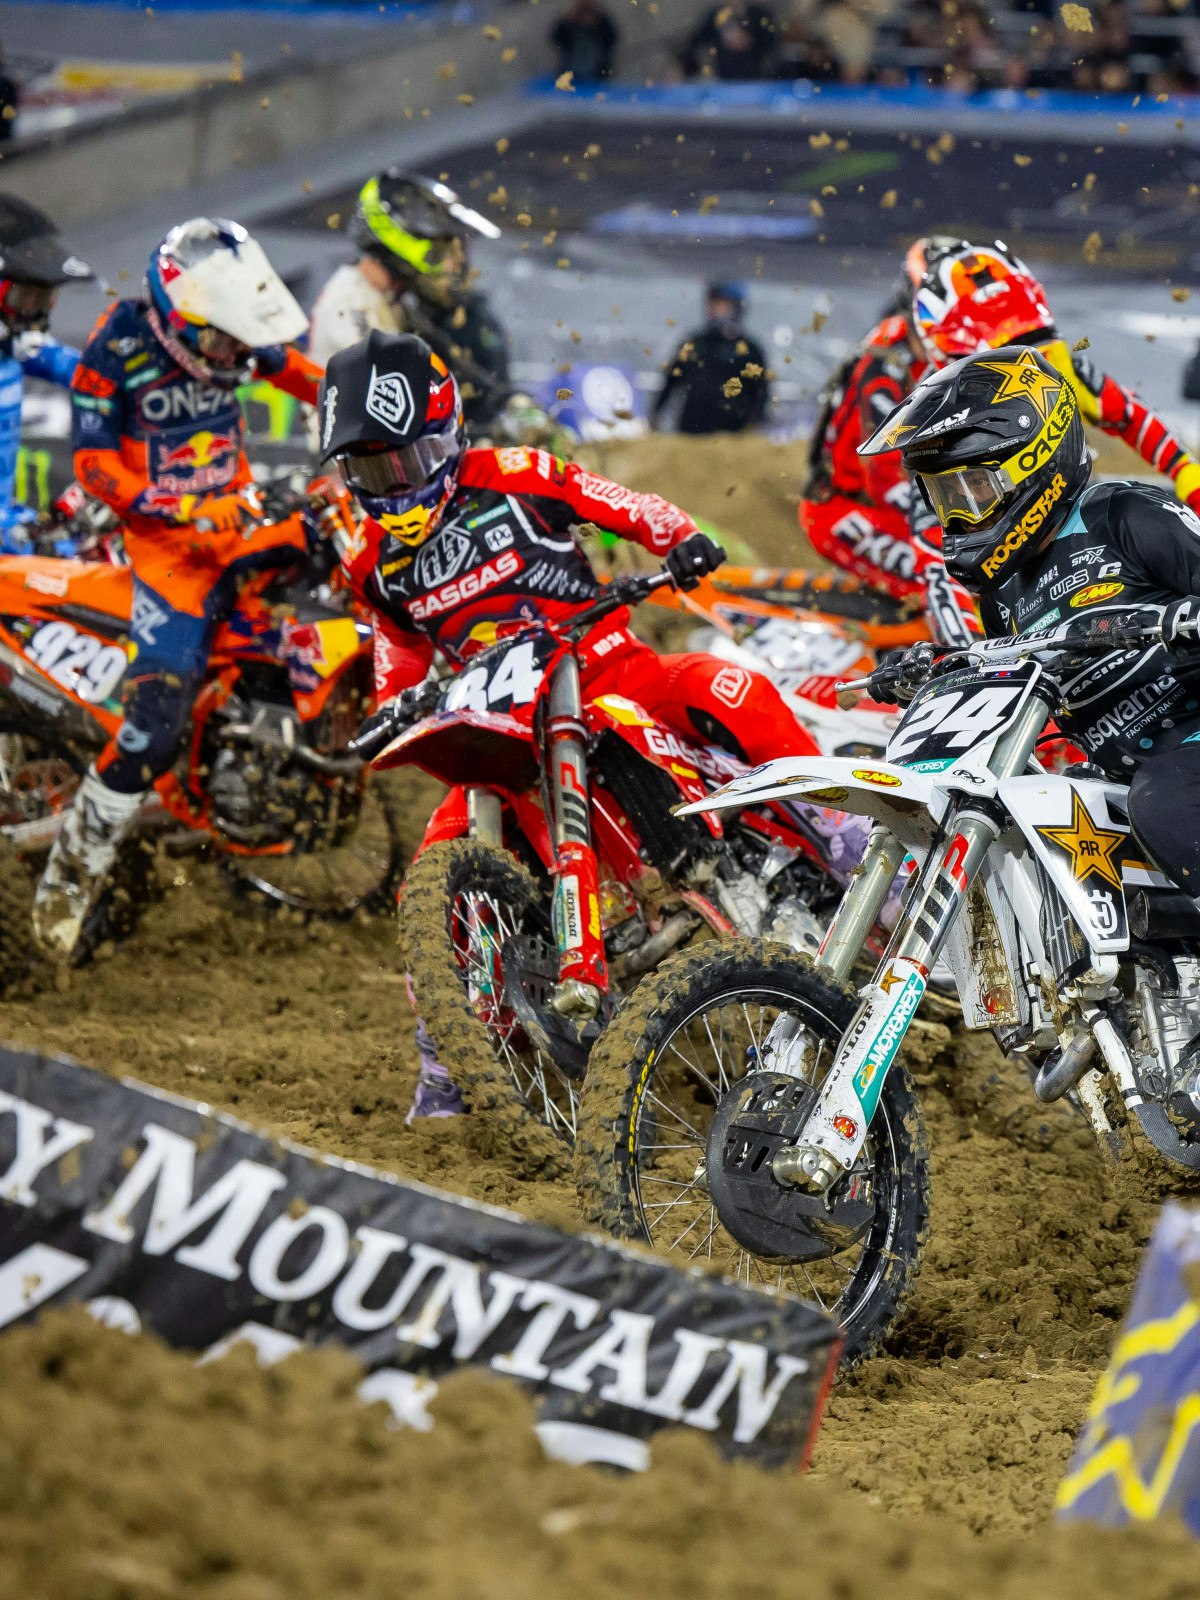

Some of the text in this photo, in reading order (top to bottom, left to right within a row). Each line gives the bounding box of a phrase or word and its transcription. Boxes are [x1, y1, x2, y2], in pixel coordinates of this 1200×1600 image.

[934, 419, 967, 437] RACING
[981, 472, 1067, 579] ROCKSTAR
[1071, 547, 1105, 567] SMX
[408, 552, 519, 620] GASGAS
[1049, 568, 1090, 600] WPS
[1070, 582, 1124, 607] FMF
[24, 620, 129, 704] 929
[1071, 649, 1141, 697] RACING
[887, 686, 1024, 763] 24
[1083, 675, 1177, 752] usqvarna
[1126, 711, 1158, 739] FACTORY
[1157, 687, 1187, 714] RACING
[854, 770, 901, 787] FMF
[568, 888, 580, 939] DUNLOP
[868, 979, 922, 1068] MOTOREX
[81, 1123, 808, 1444] MOUNTAIN
